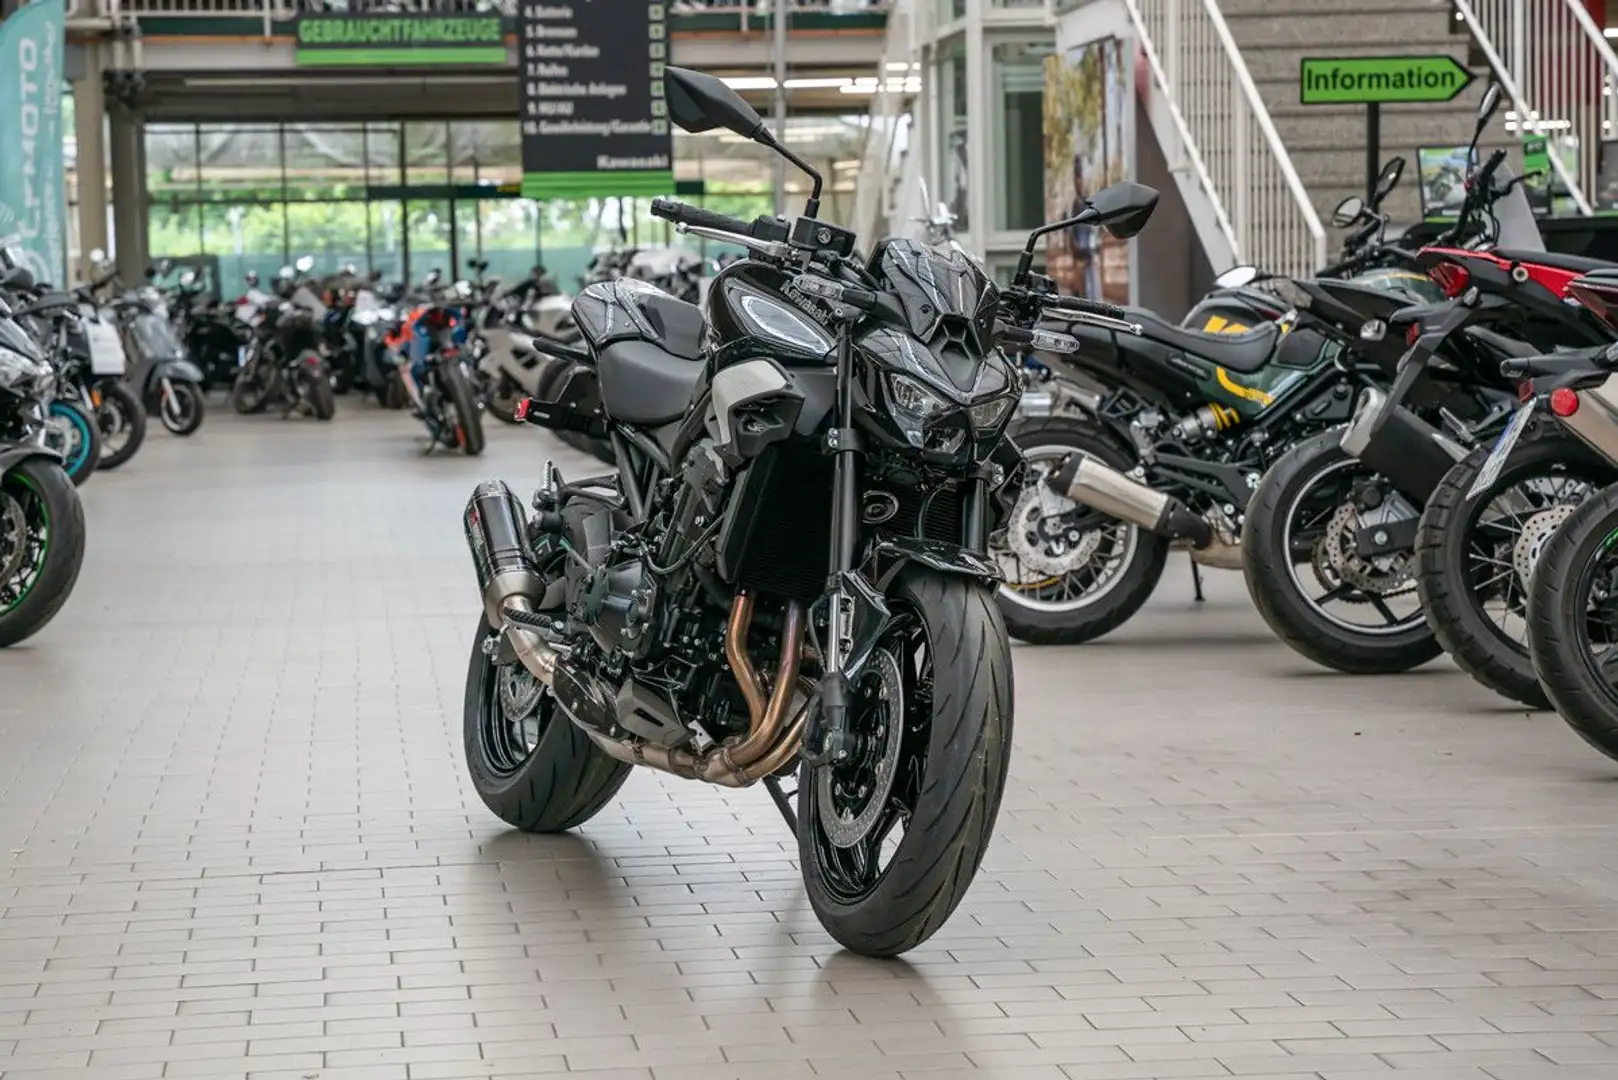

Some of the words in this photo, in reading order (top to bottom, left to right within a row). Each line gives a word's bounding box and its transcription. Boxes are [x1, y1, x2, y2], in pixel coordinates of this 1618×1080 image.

[300, 18, 500, 43] GEBRAUCHTFAHRZEUGE
[1307, 66, 1456, 91] Information
[597, 154, 669, 168] Kawasaki
